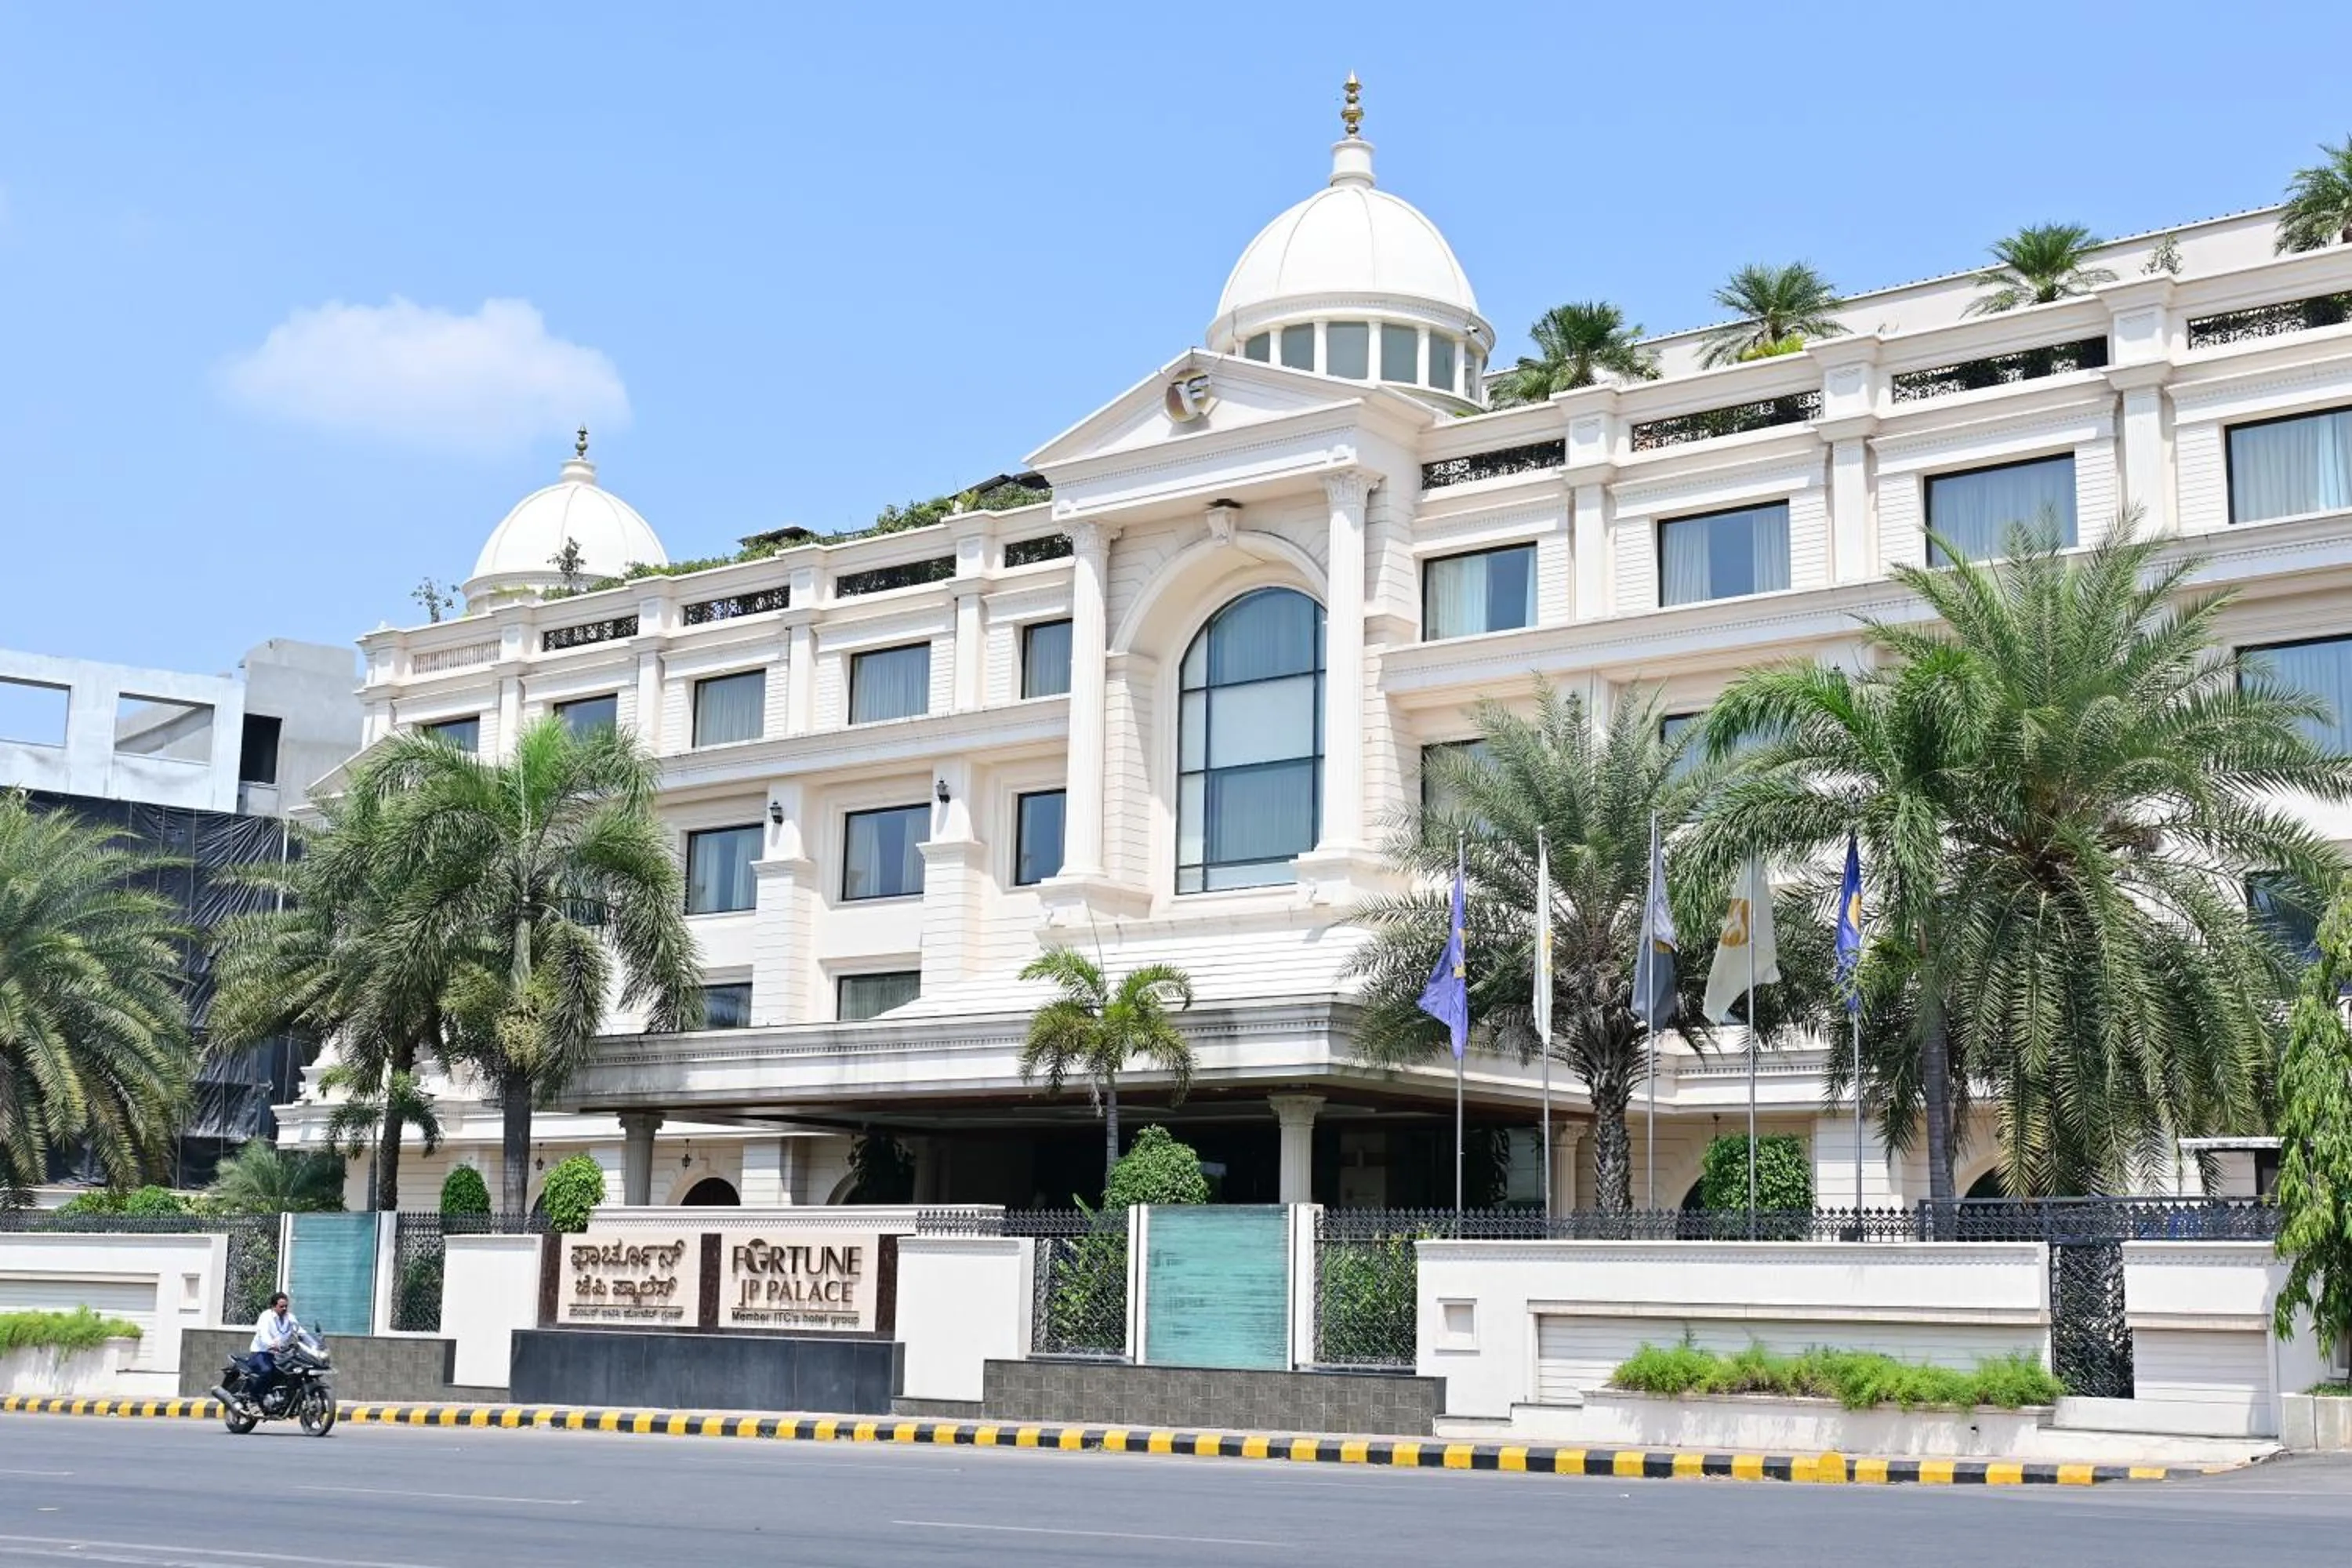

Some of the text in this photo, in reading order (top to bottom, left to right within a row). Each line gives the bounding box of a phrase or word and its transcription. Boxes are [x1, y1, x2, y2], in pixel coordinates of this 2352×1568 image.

[731, 1238, 862, 1276] FORTUNE
[738, 1279, 854, 1306] JP PALACE
[731, 1310, 860, 1327] Member ITC's hotel group
